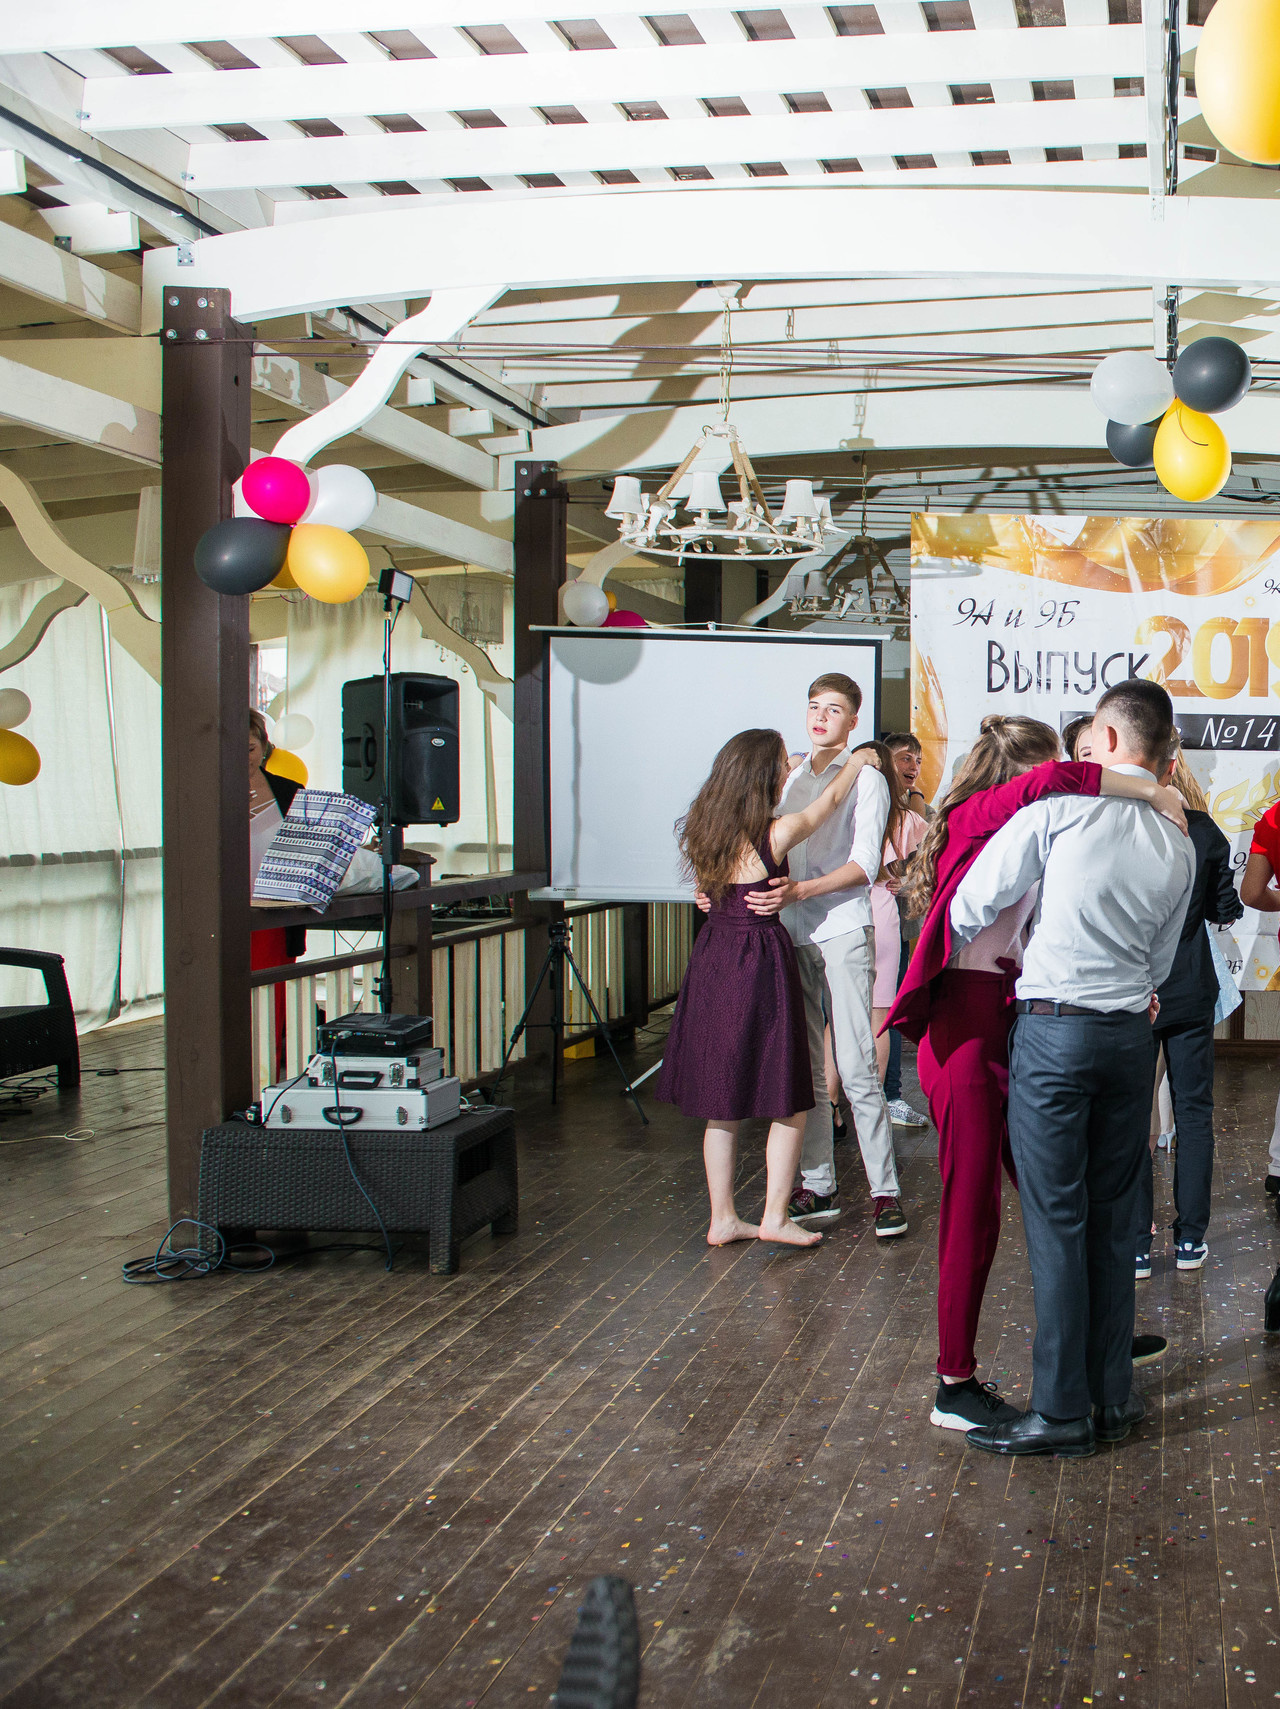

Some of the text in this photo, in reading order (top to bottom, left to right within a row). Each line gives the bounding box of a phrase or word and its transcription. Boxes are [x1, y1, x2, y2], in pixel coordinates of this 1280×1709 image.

[952, 597, 1081, 629] 9А и 9Б
[987, 639, 1150, 695] Выпуск
[1232, 851, 1247, 872] 9
